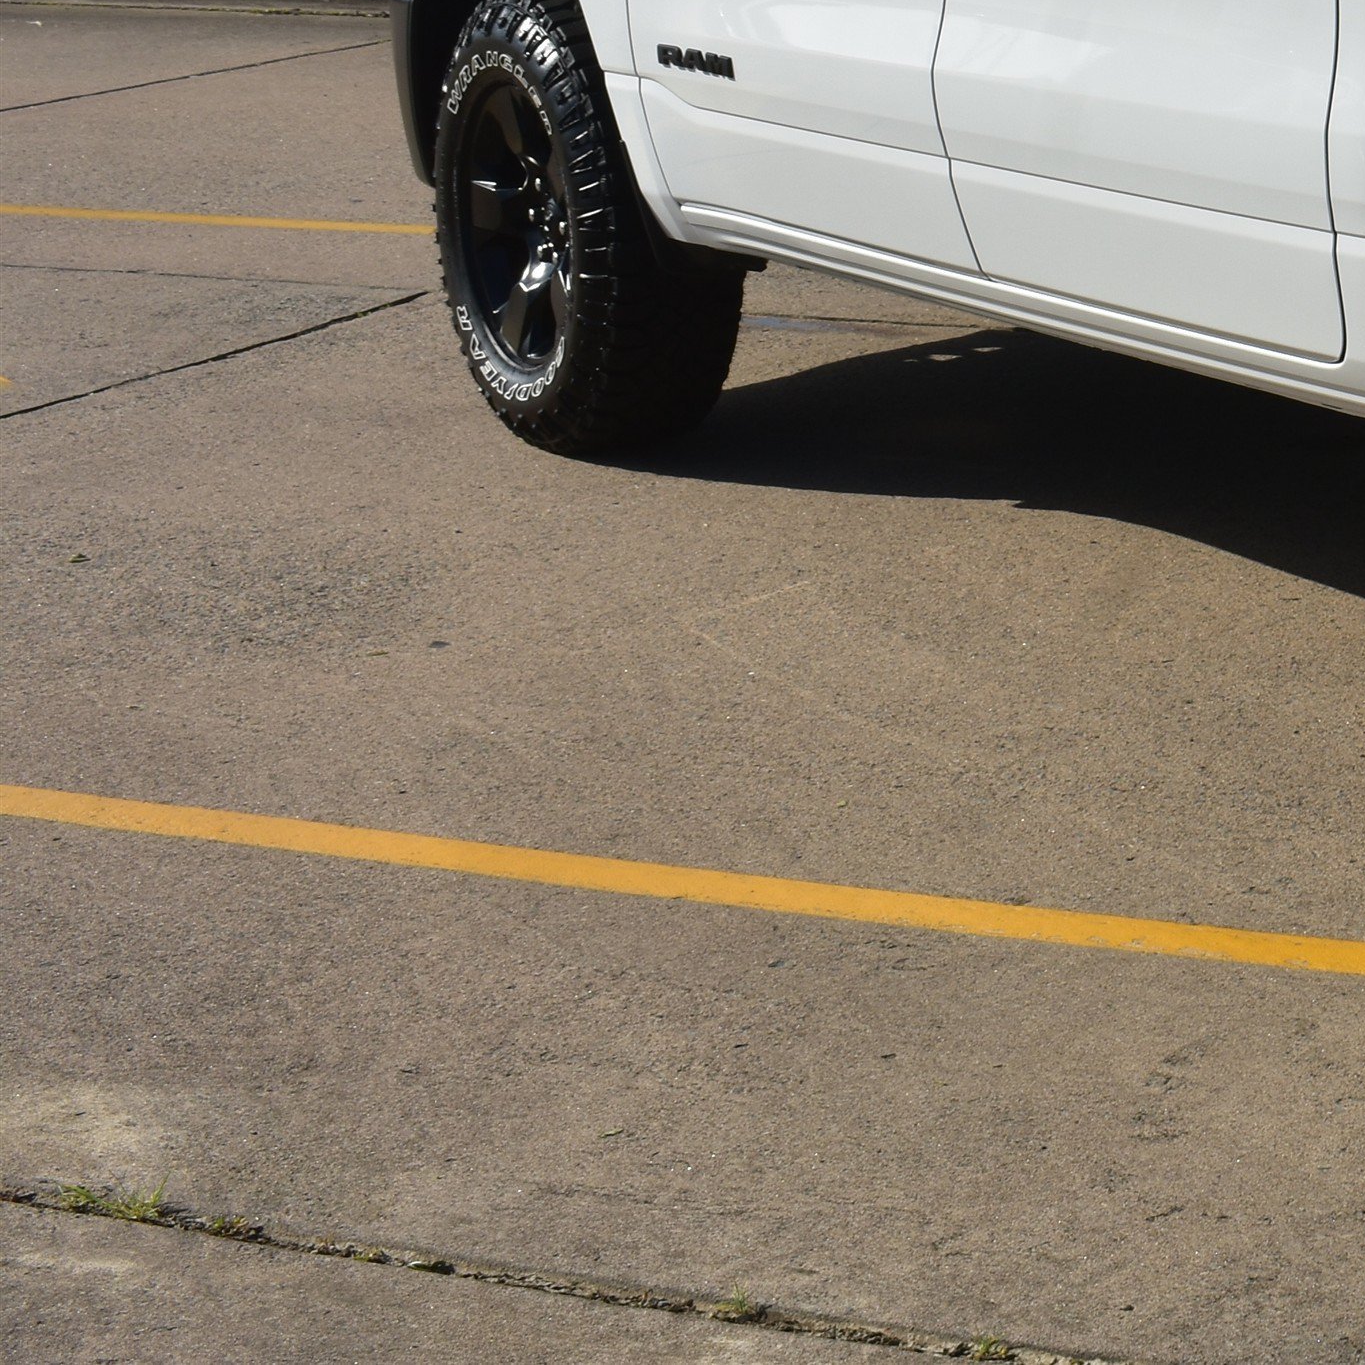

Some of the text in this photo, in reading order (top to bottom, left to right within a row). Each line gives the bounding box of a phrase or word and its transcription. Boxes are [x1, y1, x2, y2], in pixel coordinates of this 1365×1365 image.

[446, 50, 552, 136] WRANGLER
[657, 43, 736, 81] RAM
[456, 305, 565, 401] GOODYEAR
